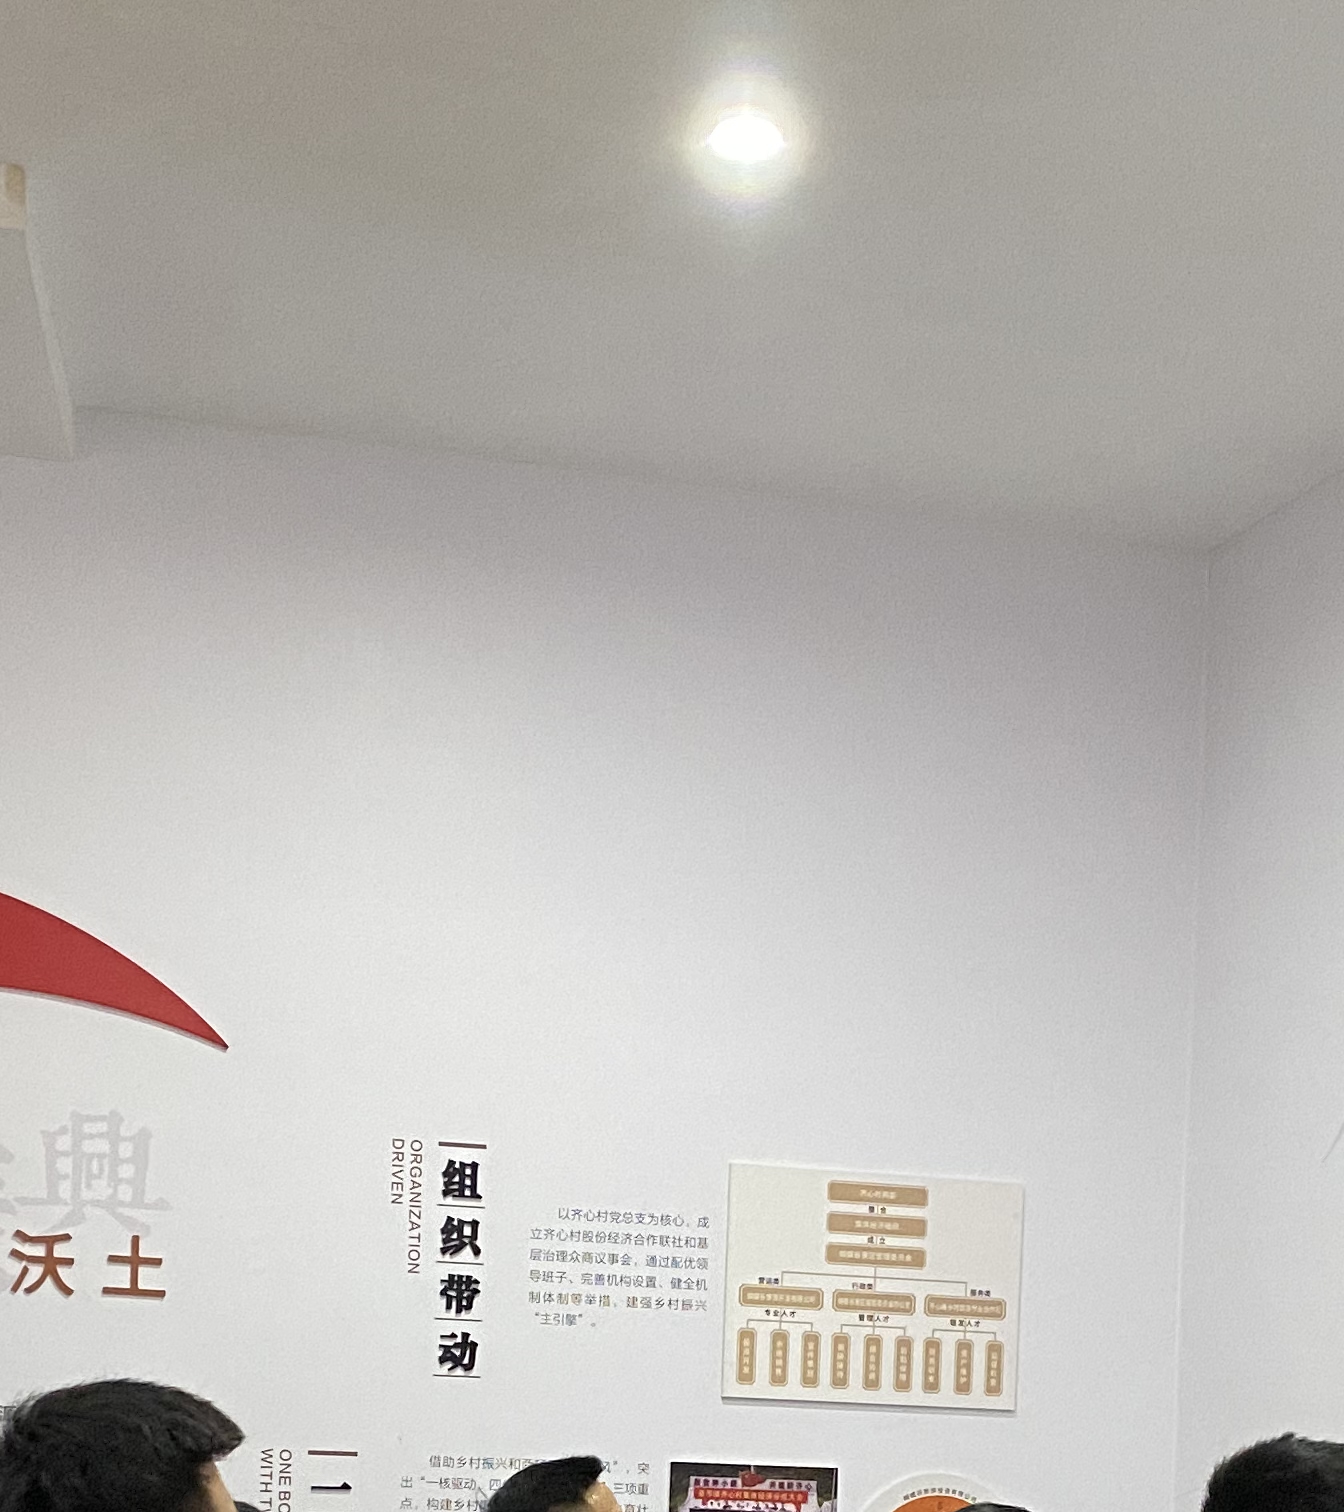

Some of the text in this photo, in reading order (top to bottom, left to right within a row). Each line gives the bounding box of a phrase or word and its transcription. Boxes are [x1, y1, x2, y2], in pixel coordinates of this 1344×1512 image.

[390, 1138, 405, 1205] DRIVEN
[407, 1139, 423, 1274] ORGANIZATION
[437, 1158, 483, 1372] 组织带动
[259, 1448, 274, 1494] WITH
[278, 1448, 293, 1488] ONE
